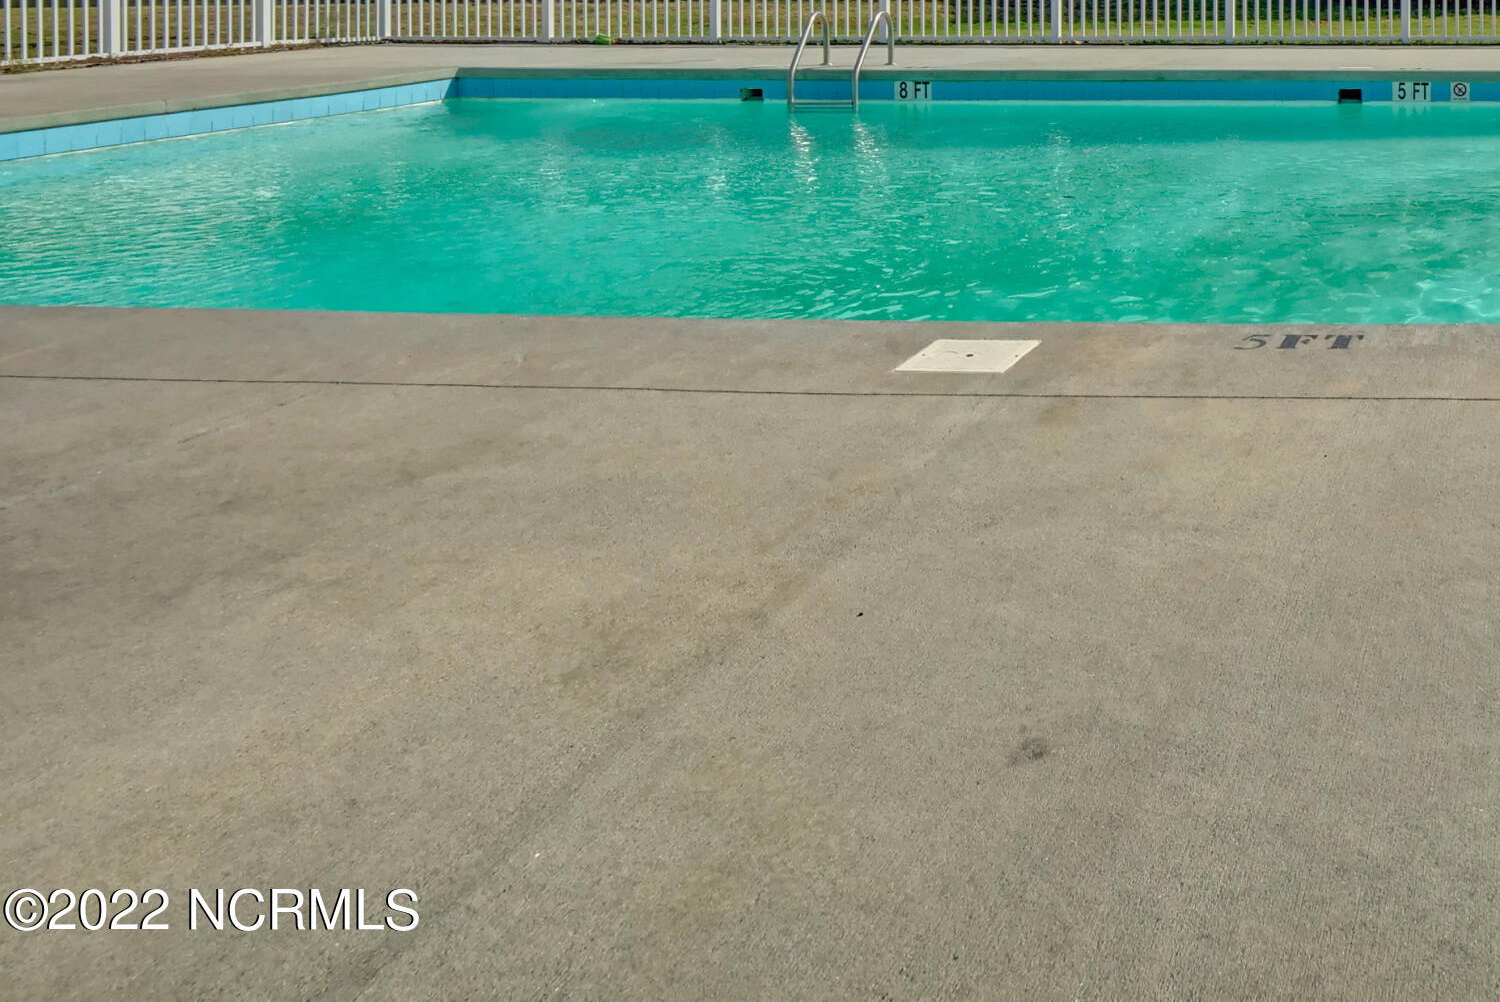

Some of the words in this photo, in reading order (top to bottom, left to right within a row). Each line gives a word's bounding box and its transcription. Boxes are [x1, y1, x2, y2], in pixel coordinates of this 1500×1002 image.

[899, 81, 908, 99] 8
[914, 81, 930, 99] FT
[1398, 82, 1406, 100] 5
[1412, 82, 1429, 100] FT
